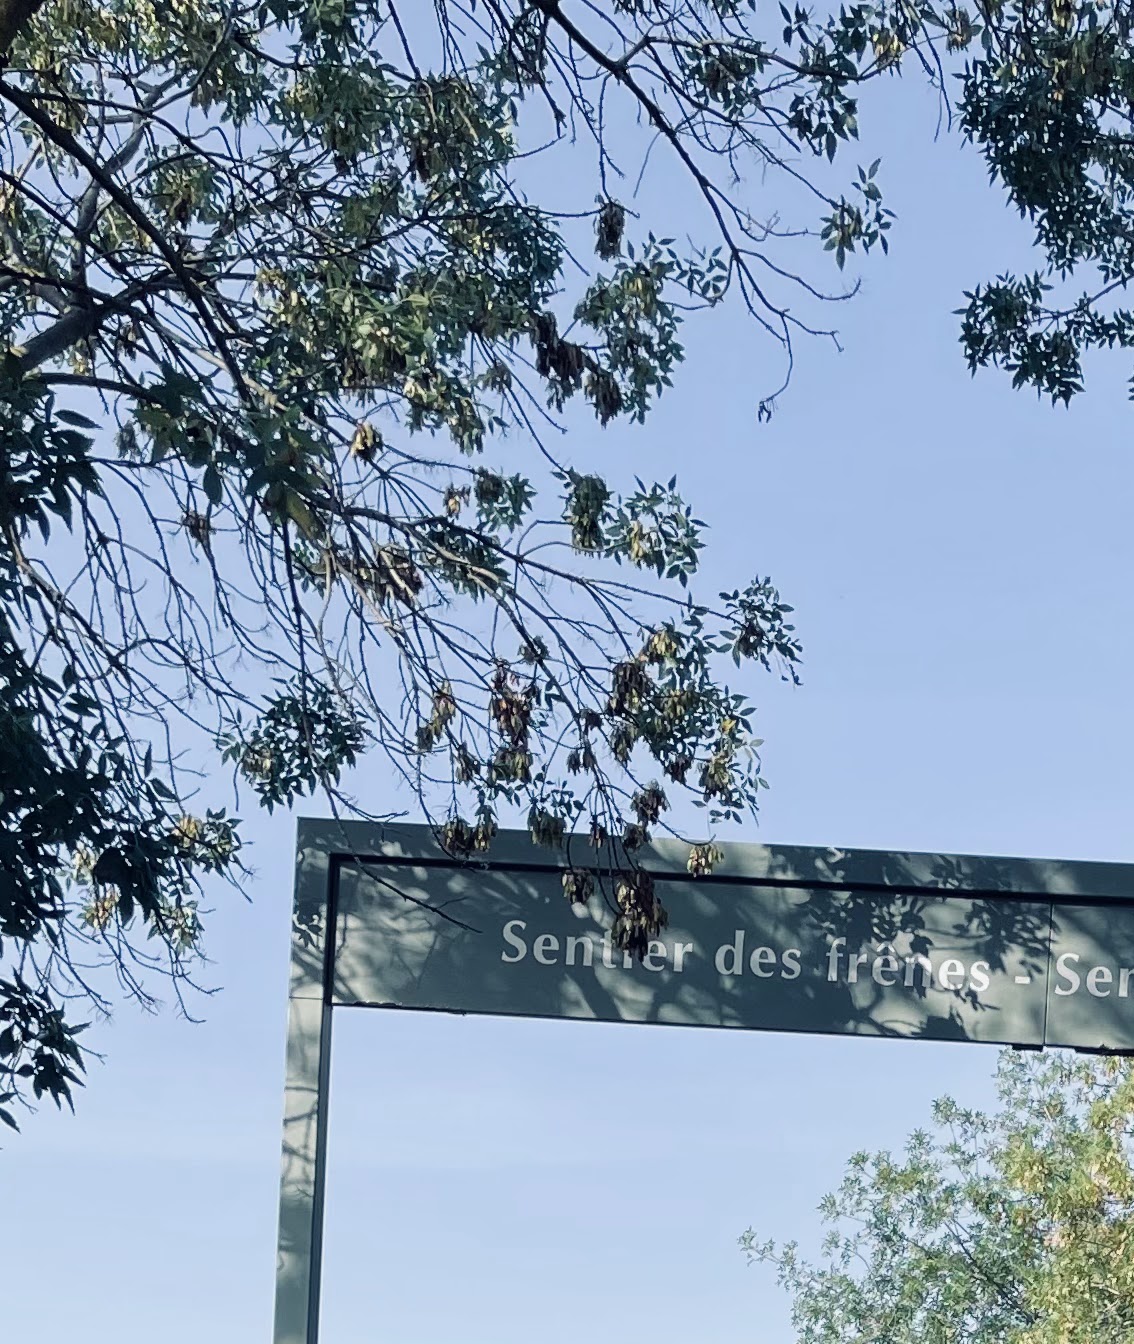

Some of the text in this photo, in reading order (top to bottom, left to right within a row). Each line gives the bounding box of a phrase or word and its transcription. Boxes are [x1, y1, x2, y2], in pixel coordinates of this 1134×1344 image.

[715, 930, 802, 980] des
[825, 936, 991, 992] frênes
[1014, 975, 1031, 985] -
